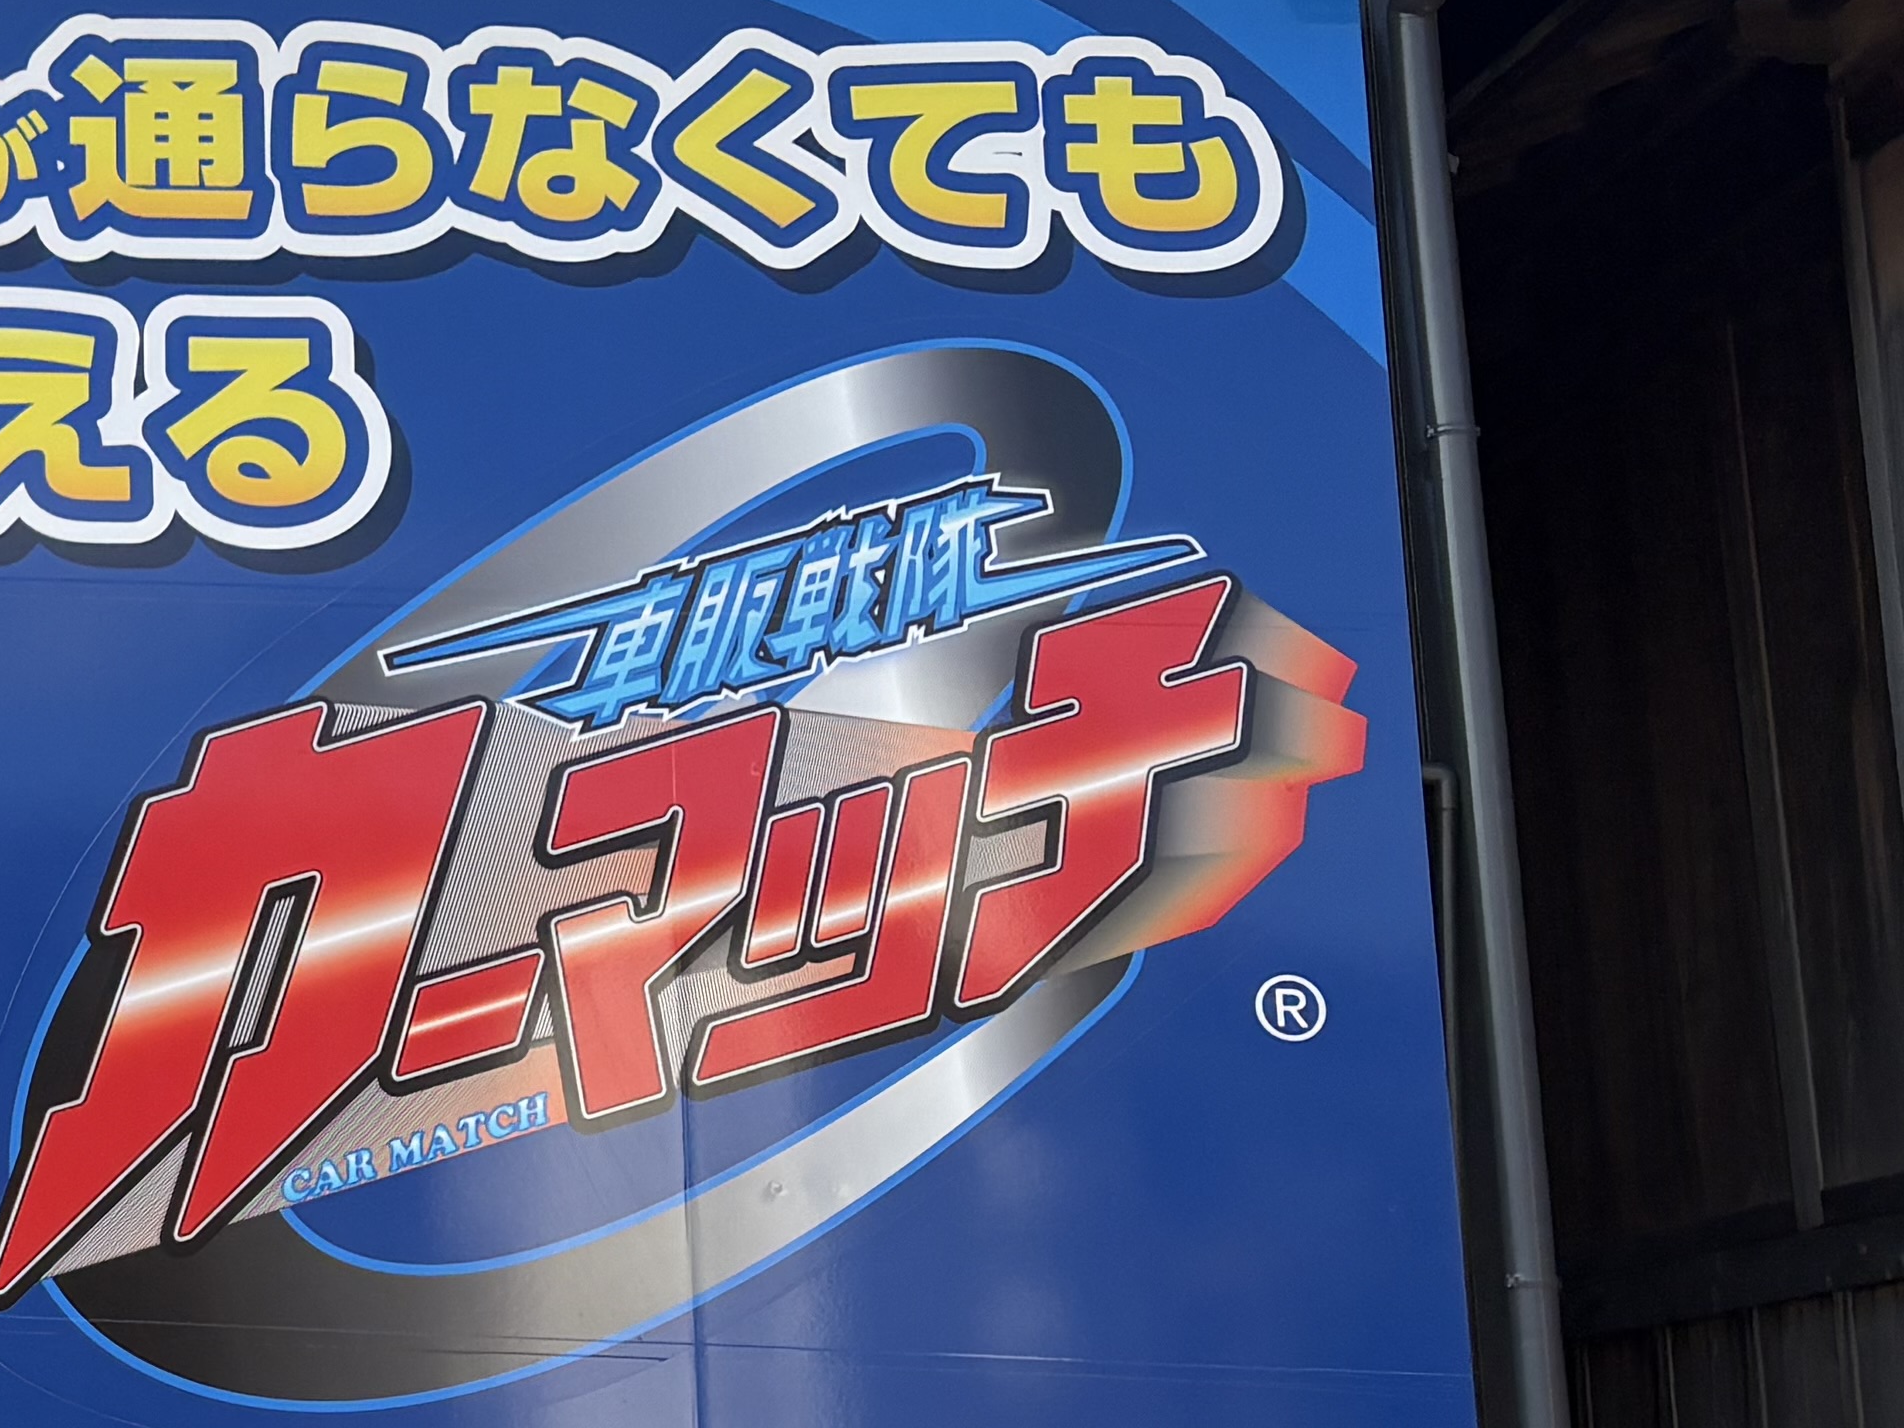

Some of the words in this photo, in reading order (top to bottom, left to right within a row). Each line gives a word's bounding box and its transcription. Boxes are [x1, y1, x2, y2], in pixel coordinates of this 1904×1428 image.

[388, 477, 1196, 732] 車販戦隊
[281, 1147, 378, 1203] CAR
[389, 1091, 548, 1173] MATCH
